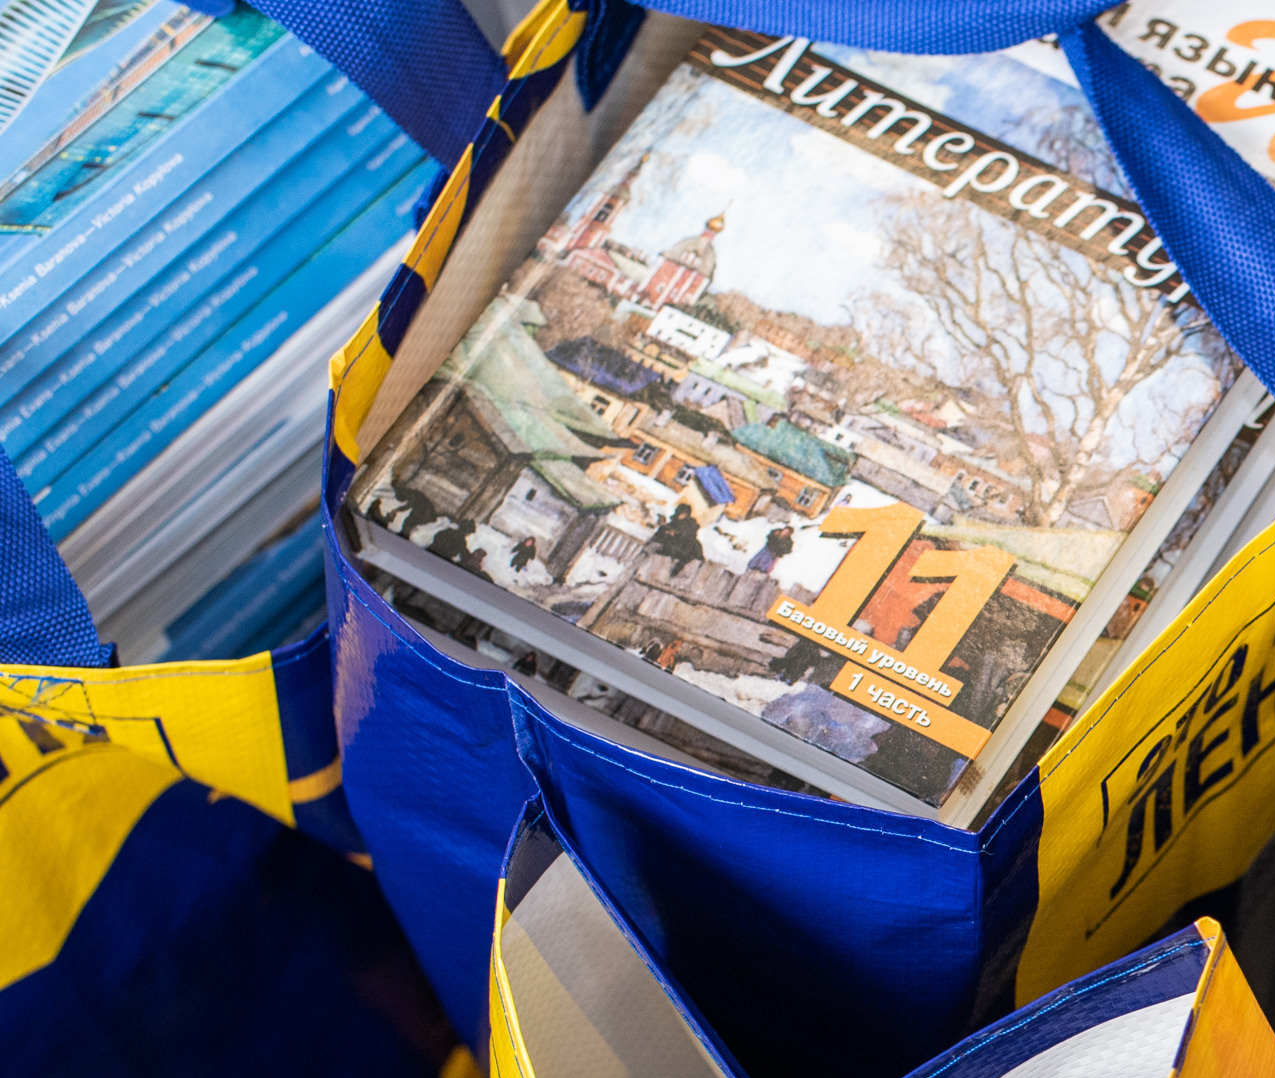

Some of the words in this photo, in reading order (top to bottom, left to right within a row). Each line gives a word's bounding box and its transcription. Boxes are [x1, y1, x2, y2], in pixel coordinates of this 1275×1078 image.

[711, 36, 1190, 302] Литерату
[776, 600, 868, 655] Базовый
[867, 648, 952, 698] уровень
[809, 501, 1017, 672] 11
[848, 673, 864, 691] 1
[867, 683, 932, 728] часть
